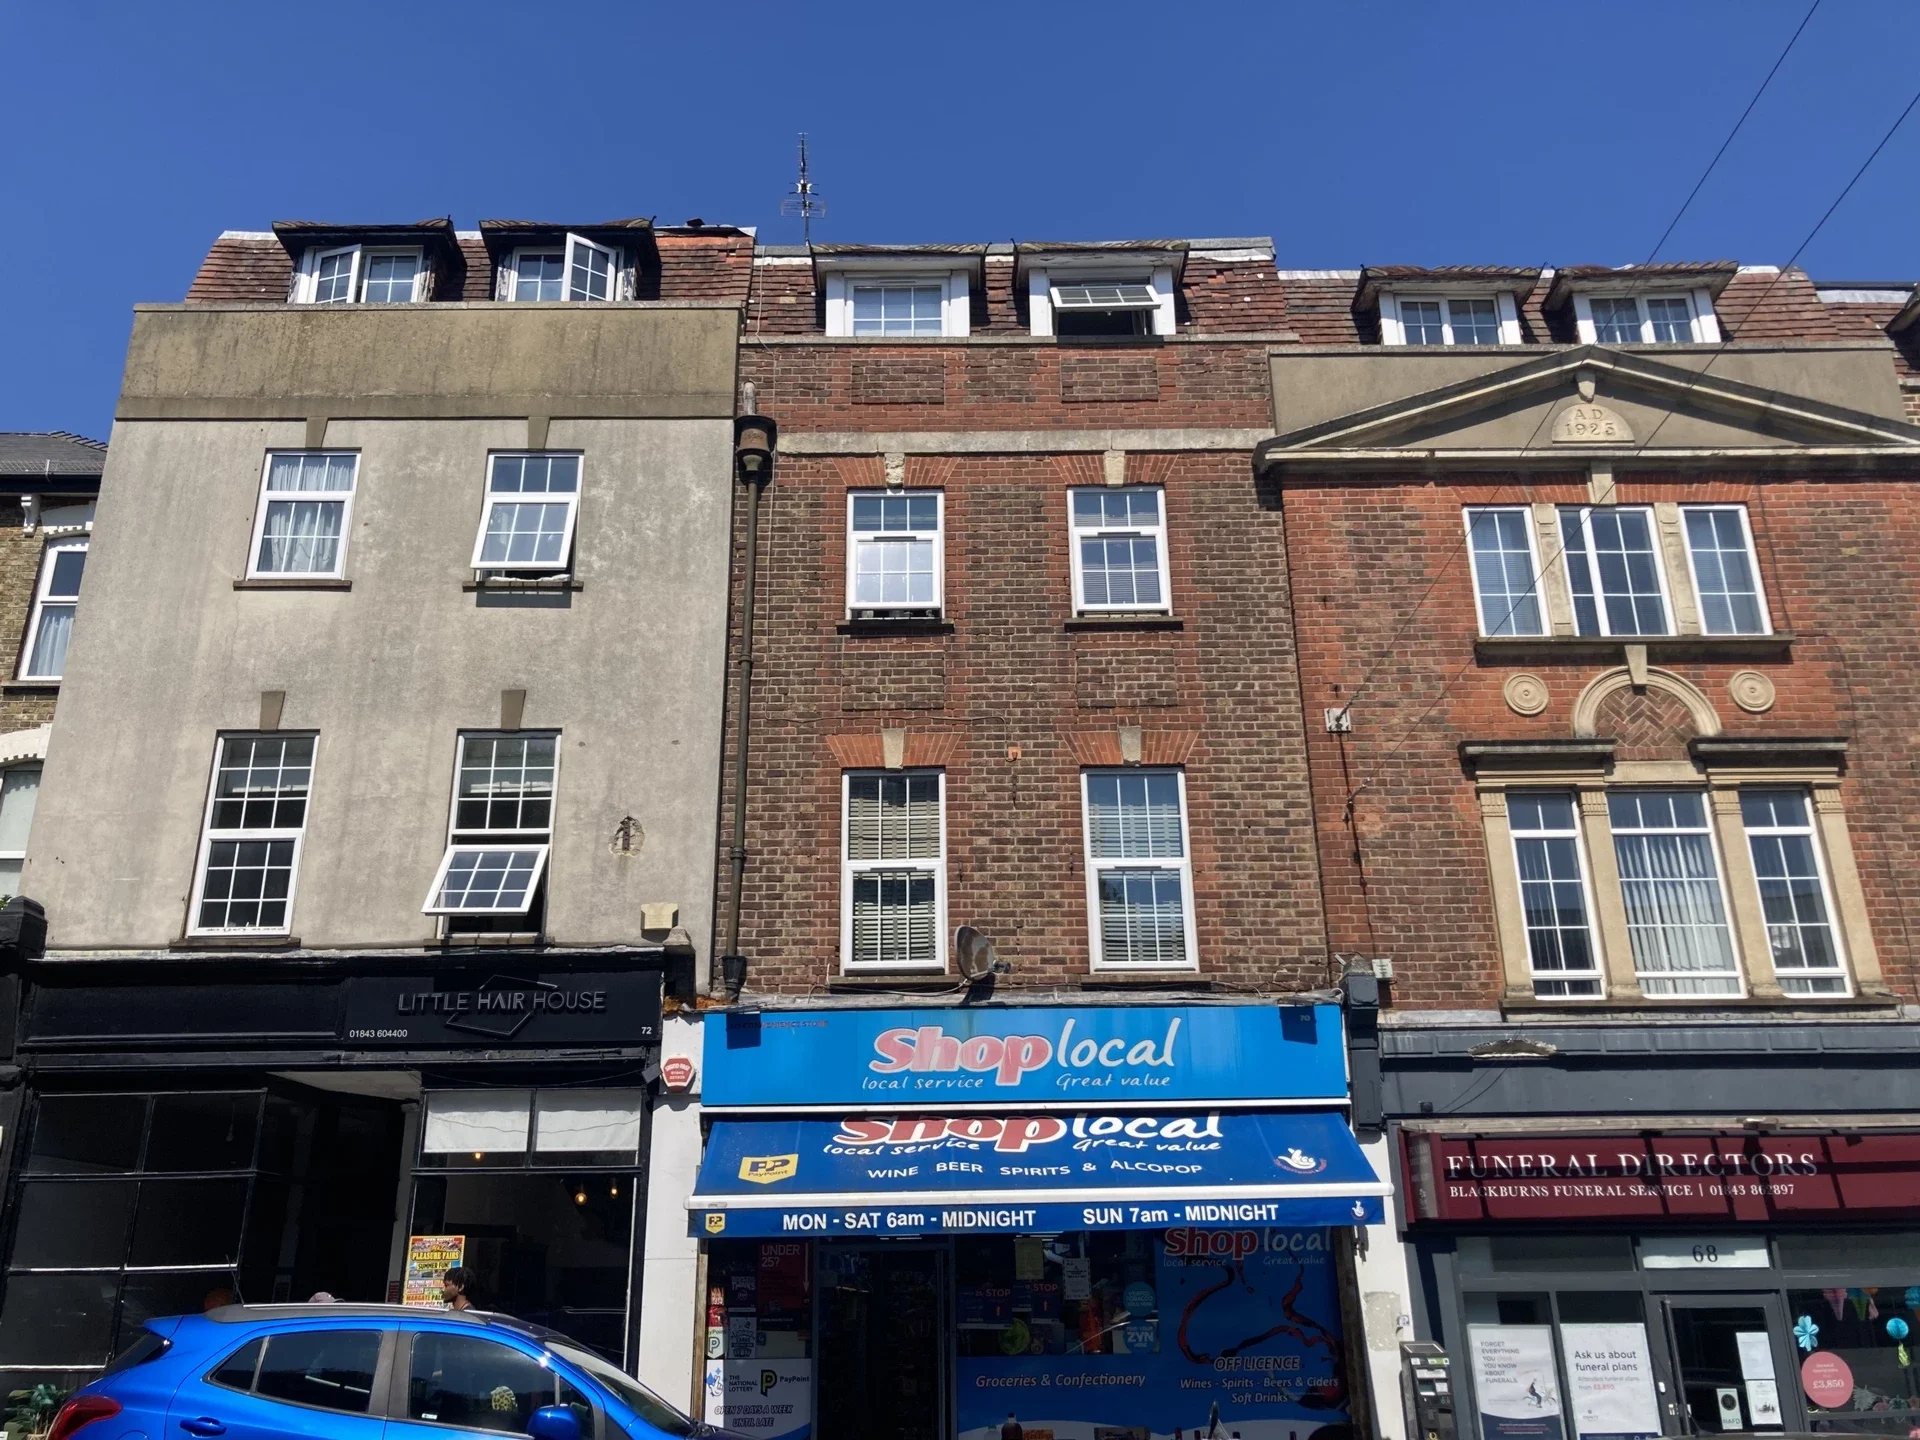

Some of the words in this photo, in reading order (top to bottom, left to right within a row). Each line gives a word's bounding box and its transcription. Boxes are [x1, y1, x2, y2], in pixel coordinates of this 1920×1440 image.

[398, 993, 472, 1012] LITTLE
[477, 992, 525, 1010] HAIR
[533, 991, 606, 1009] HOUSE
[1300, 1014, 1311, 1022] 70
[349, 1029, 375, 1038] 01843
[377, 1028, 408, 1037] 604400
[641, 1027, 652, 1035] 72
[868, 1026, 1054, 1086] Shop
[1056, 1017, 1182, 1068] local
[862, 1076, 908, 1091] local
[914, 1074, 984, 1090] service
[1056, 1072, 1115, 1092] Great
[1121, 1074, 1171, 1088] value
[1072, 1110, 1224, 1139] local
[823, 1143, 882, 1156] local
[890, 1138, 981, 1156] service
[1072, 1138, 1149, 1153] Great
[1156, 1140, 1222, 1152] value
[868, 1165, 919, 1179] WINE
[935, 1162, 984, 1174] BEER
[1000, 1165, 1071, 1176] SPIRITS
[1082, 1162, 1097, 1172] &
[1110, 1160, 1203, 1174] ALCOPOP
[1446, 1154, 1608, 1179] FUNERAL
[1616, 1153, 1818, 1177] DIRECTORS
[748, 1169, 789, 1177] PayPoint
[1450, 1185, 1549, 1198] BLACKBURNS
[1554, 1185, 1626, 1197] FUNERAL
[1630, 1184, 1693, 1196] SERVICE
[1710, 1184, 1746, 1196] 01843
[1750, 1184, 1795, 1196] 862897
[783, 1213, 827, 1230] MON
[844, 1212, 881, 1229] SAT
[886, 1212, 925, 1228] 6am
[942, 1210, 1036, 1228] MIDNIGHT
[1082, 1208, 1123, 1225] SUN
[1129, 1206, 1169, 1223] 7am
[1184, 1204, 1279, 1222] MIDNIGHT
[1163, 1227, 1260, 1261] Shop
[1263, 1226, 1333, 1252] local
[412, 1252, 441, 1260] PLEASURE
[442, 1252, 459, 1260] FAIRS
[761, 1244, 800, 1256] UNDER
[1691, 1244, 1719, 1263] 68
[761, 1256, 780, 1268] 25?
[1163, 1257, 1187, 1268] local
[1190, 1257, 1228, 1267] service
[1262, 1255, 1294, 1266] Great
[1298, 1255, 1325, 1265] value
[986, 1288, 1011, 1298] STOP
[1033, 1283, 1058, 1292] STOP
[1127, 1331, 1154, 1343] ZYN
[1574, 1350, 1592, 1359] Ask
[1594, 1351, 1606, 1359] us
[1608, 1350, 1637, 1359] about
[1214, 1356, 1243, 1371] OFF
[1244, 1355, 1300, 1371] LICENCE
[1575, 1362, 1610, 1371] funeral
[1612, 1362, 1638, 1373] plans
[779, 1375, 810, 1384] PayPoint
[975, 1374, 1037, 1388] Groceries
[1040, 1373, 1051, 1387] &
[1055, 1372, 1146, 1389] Confectionery
[1180, 1378, 1213, 1389] Wines
[1221, 1376, 1254, 1390] Spirits
[1263, 1376, 1294, 1388] Beers
[1294, 1376, 1304, 1387] &
[1306, 1376, 1339, 1388] Ciders
[1812, 1378, 1845, 1390] £3,850
[1231, 1391, 1253, 1404] Soft
[1254, 1390, 1289, 1403] Drinks
[714, 1405, 737, 1415] OPEN
[743, 1405, 763, 1414] DAYS
[771, 1404, 794, 1414] WEEK
[732, 1418, 754, 1428] UNTIL
[754, 1417, 775, 1427] LATE
